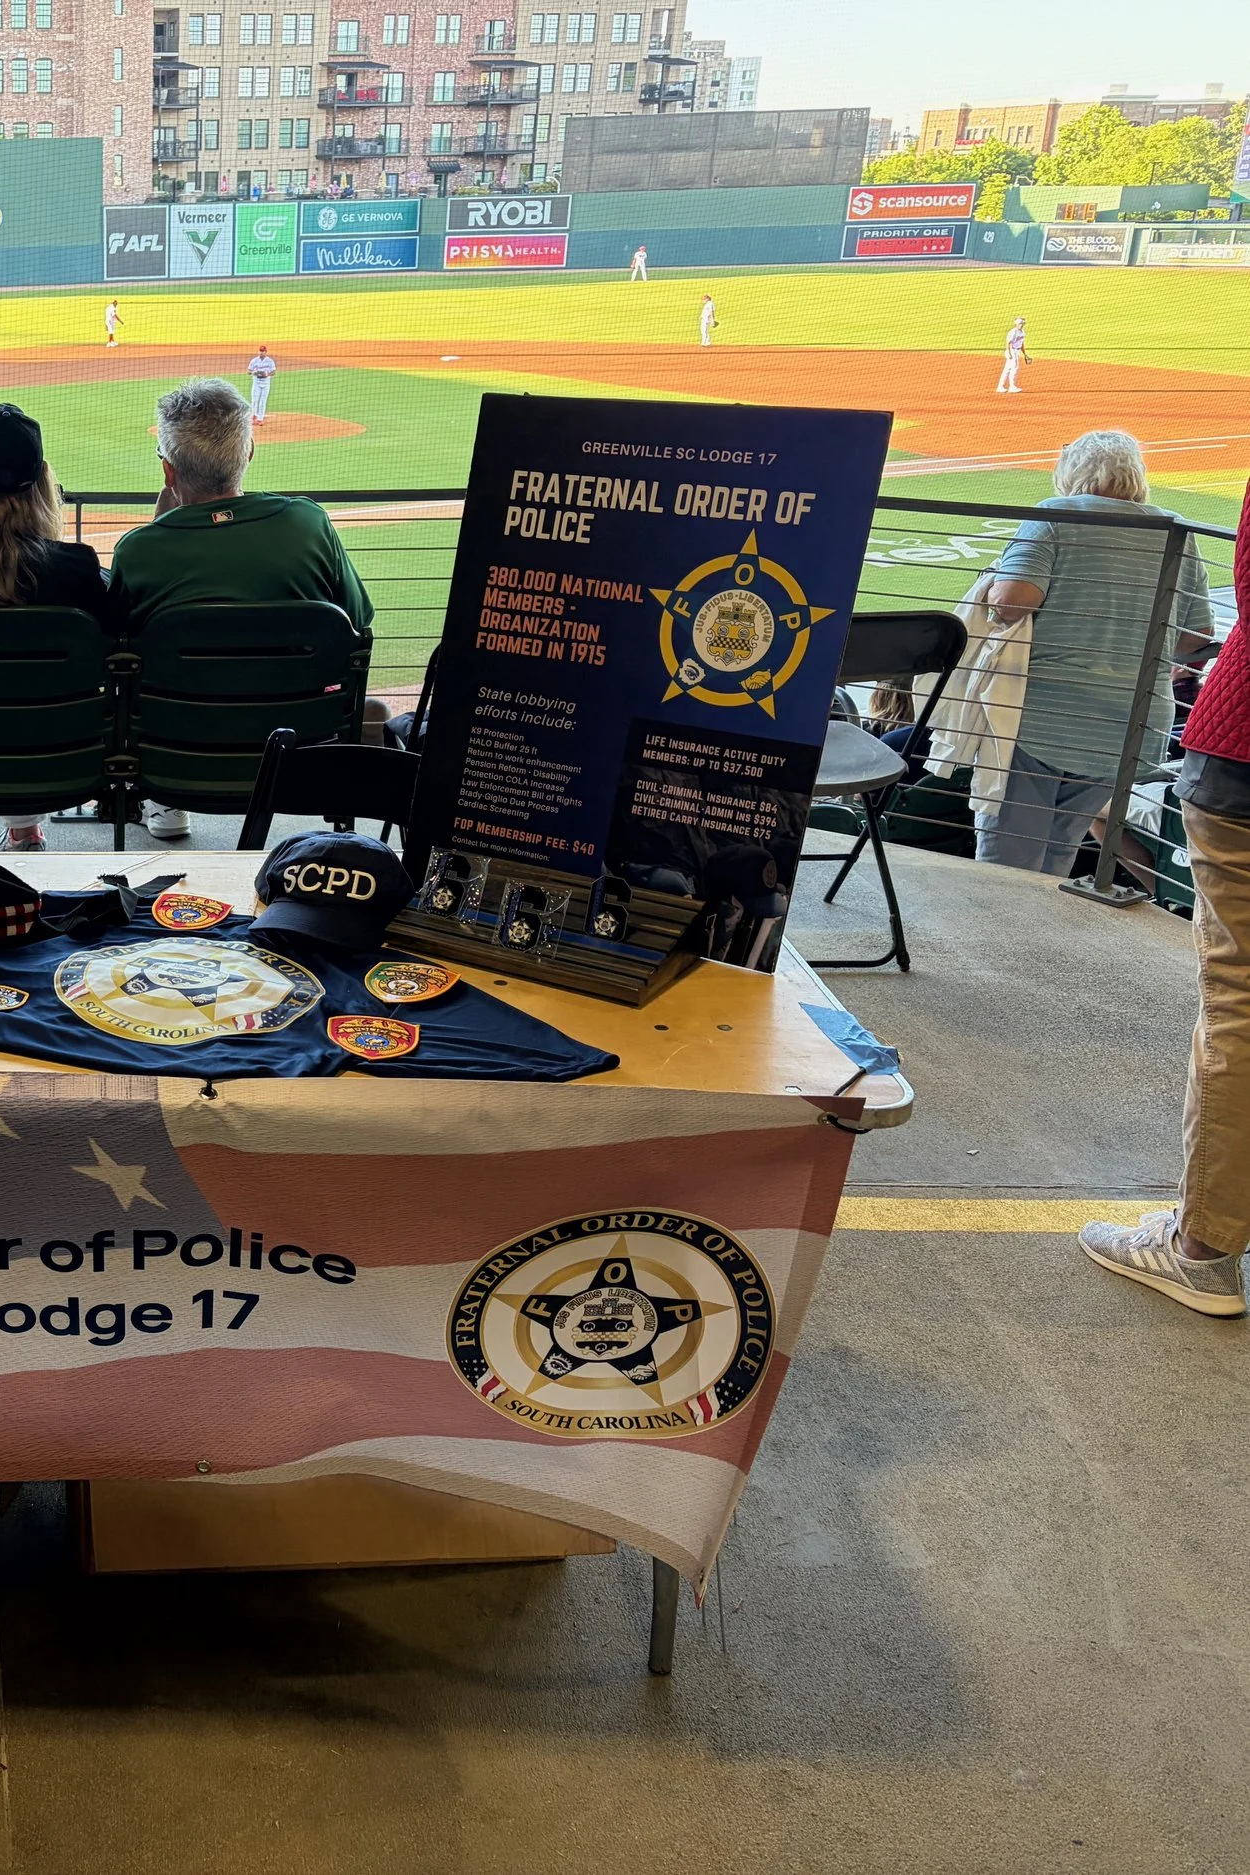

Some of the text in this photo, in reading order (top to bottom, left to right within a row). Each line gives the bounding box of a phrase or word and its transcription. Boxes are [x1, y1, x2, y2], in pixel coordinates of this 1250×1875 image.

[467, 200, 553, 226] RYOBI
[878, 194, 968, 208] scansource
[177, 211, 227, 224] Vermeer
[341, 212, 403, 222] GE VERNOVA
[863, 228, 949, 238] PRIORITY ONE
[1066, 243, 1123, 253] CONNECTION
[239, 244, 292, 256] Greenville
[450, 245, 514, 259] PRISMA
[581, 441, 777, 465] GREENVILLE SC LODGE 17
[509, 470, 817, 525] FRATERNAL ORDER OF
[503, 505, 595, 544] POLICE
[487, 565, 557, 593] 380,000
[475, 631, 607, 666] FORMED IN 1915
[477, 686, 577, 715] State lobbying
[474, 704, 577, 731] efforts include:
[642, 748, 763, 778] MEMBERS: UP TO $37,500
[645, 734, 667, 747] LIFE
[723, 748, 758, 763] ACTIVE
[760, 754, 787, 767] DUTY
[634, 792, 734, 819] CIVIL-CRIMINAL-ADMIN
[753, 813, 777, 828] $396
[636, 779, 704, 801] CIVIL-CRIMINAL
[759, 801, 778, 814] $84
[631, 804, 668, 820] RETIRED
[753, 827, 772, 840] $75
[283, 863, 377, 901] SCPD
[81, 1000, 230, 1040] SOUTH CAROLINA
[39, 1230, 116, 1273] of
[133, 1227, 357, 1284] Police
[192, 1289, 261, 1330] 17
[456, 1213, 767, 1378] FRATERNAL ORDER OF POLICE
[505, 1400, 688, 1431] SOUTH CAROLINA
